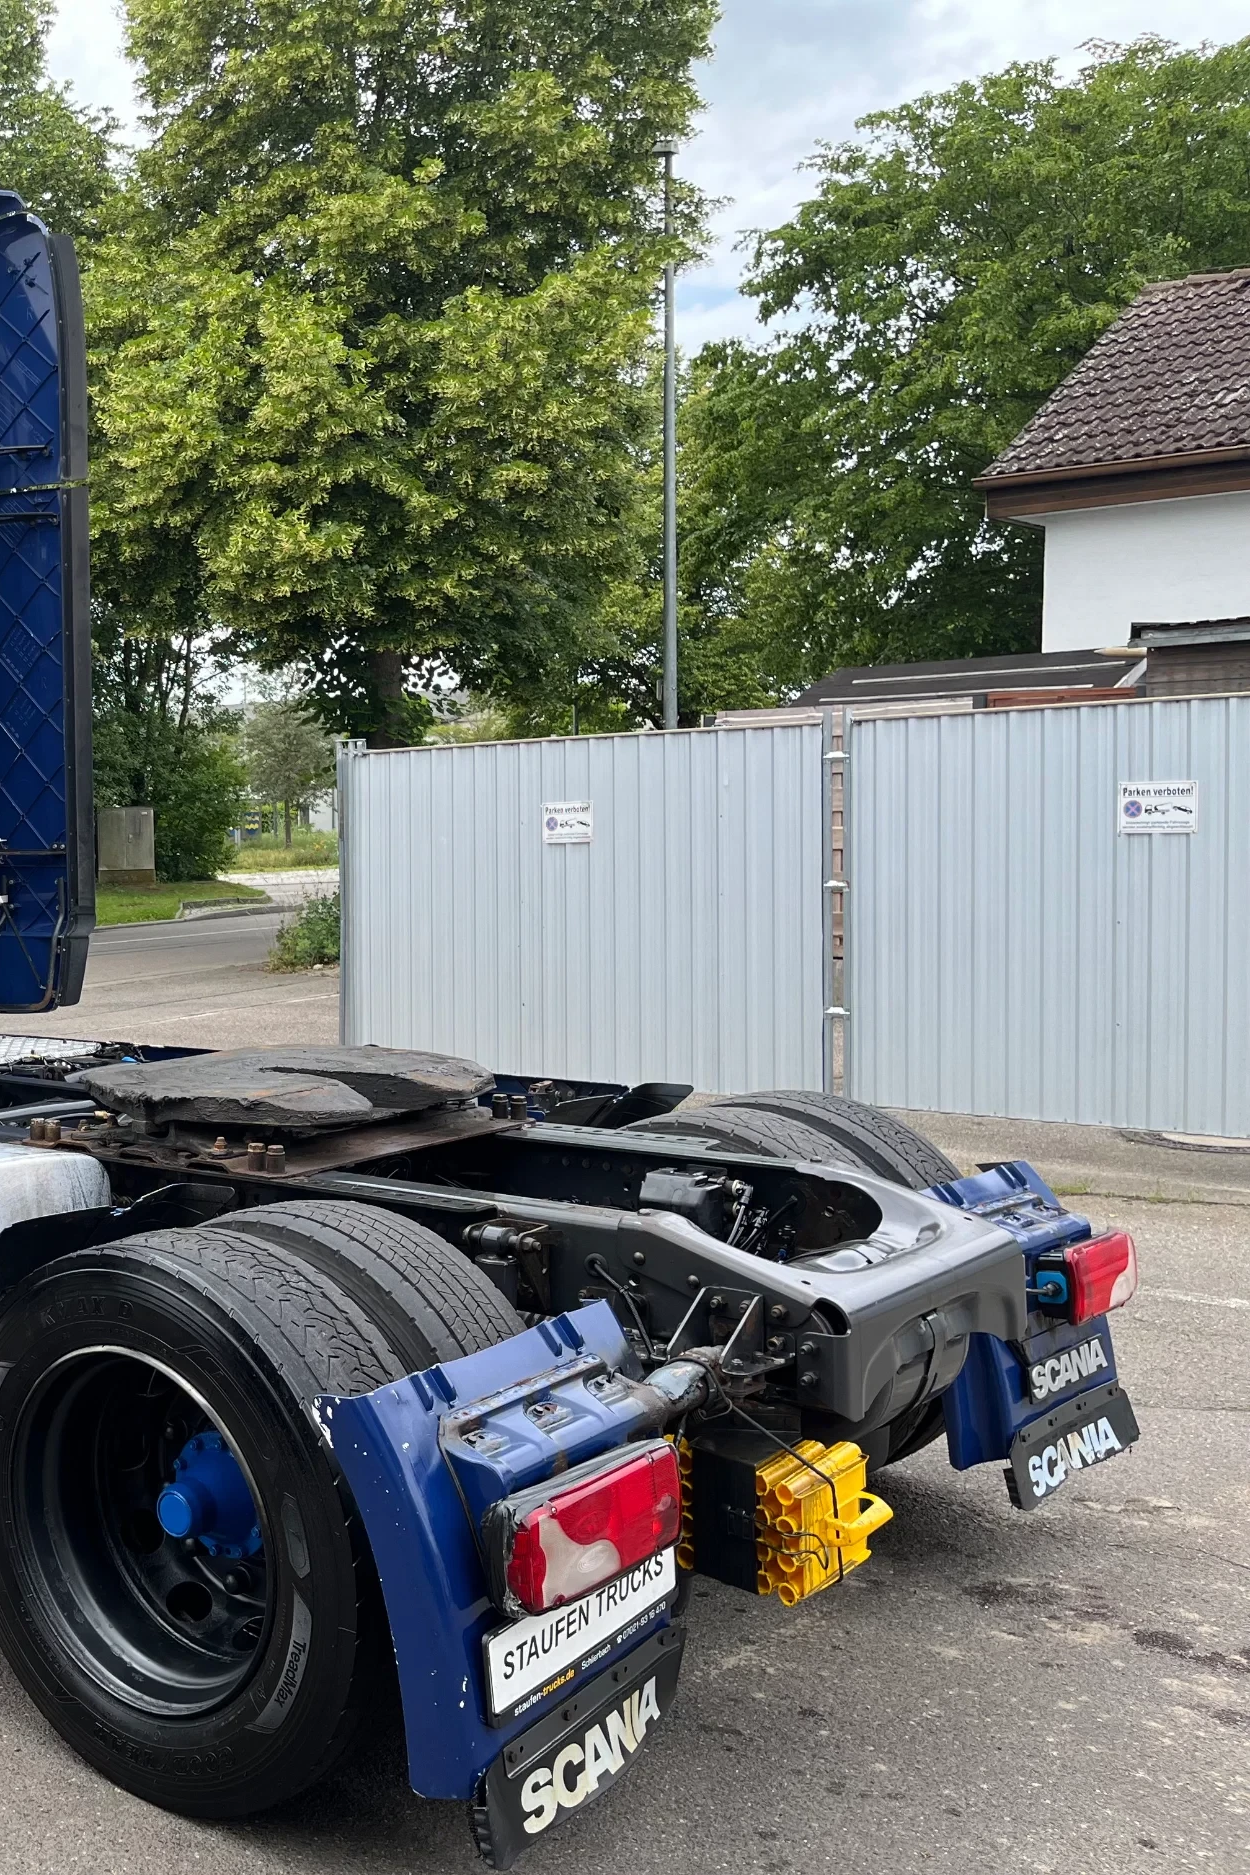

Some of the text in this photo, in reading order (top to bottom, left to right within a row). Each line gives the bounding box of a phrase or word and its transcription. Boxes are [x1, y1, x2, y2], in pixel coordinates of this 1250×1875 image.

[1123, 786, 1193, 796] Parken verboten!
[1031, 1338, 1108, 1399] SCANIA
[1028, 1416, 1122, 1497] SCANIA
[503, 1553, 664, 1680] STAUFEN TRUCKS
[275, 1640, 307, 1709] TreadMax
[514, 1668, 575, 1717] staufen-trucks.de
[581, 1644, 612, 1670] Schlierbach
[520, 1675, 661, 1834] SCANIA
